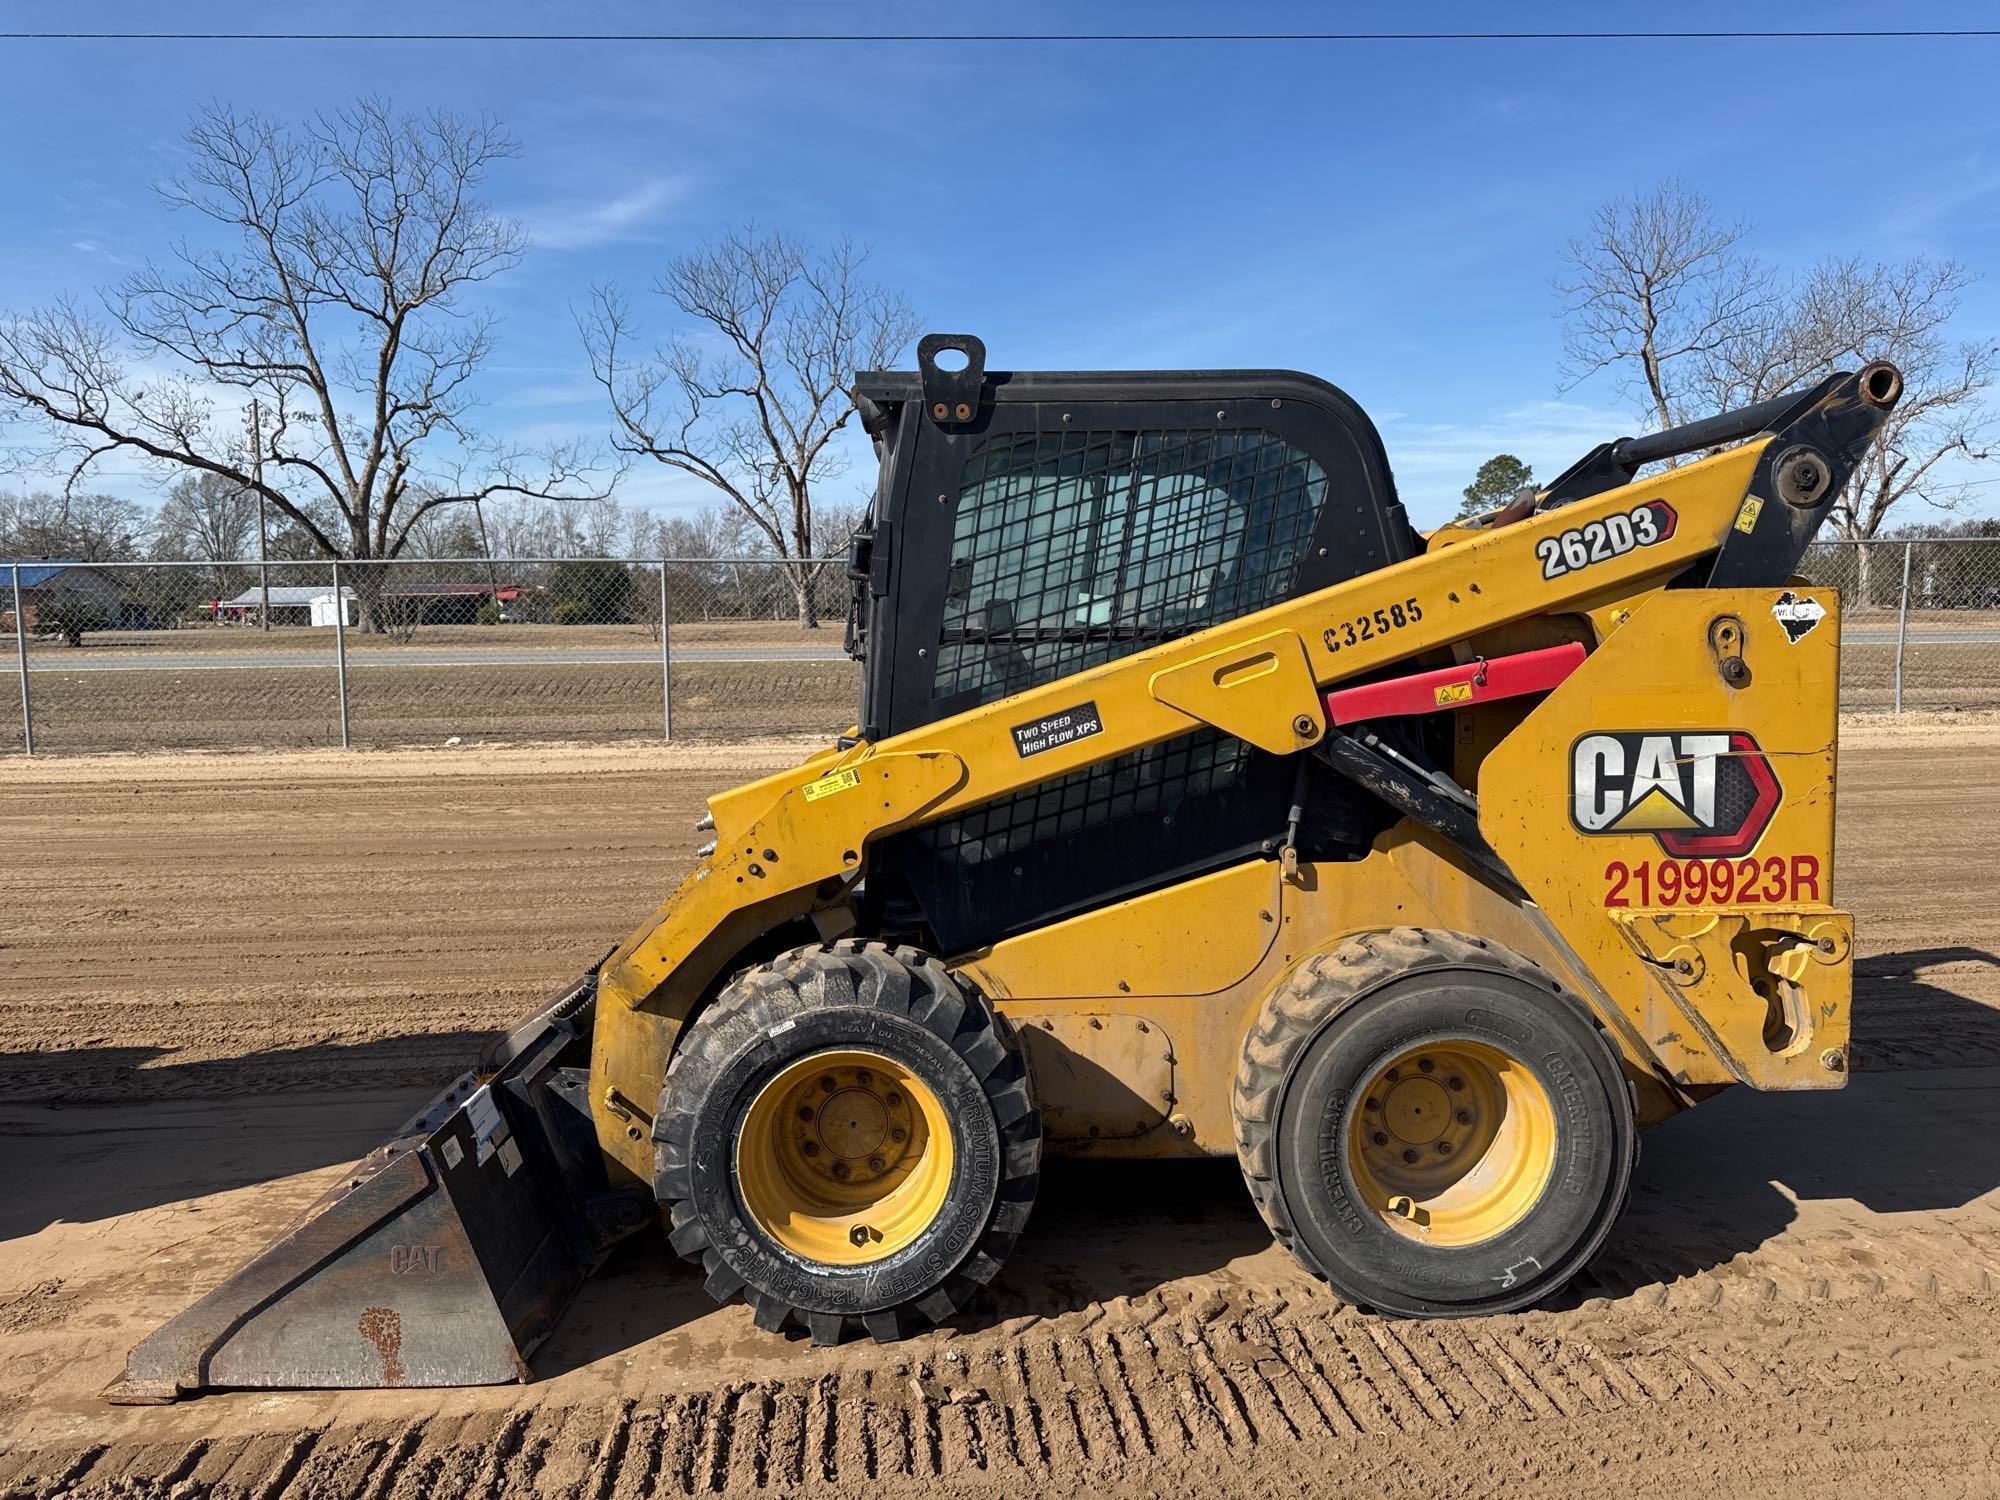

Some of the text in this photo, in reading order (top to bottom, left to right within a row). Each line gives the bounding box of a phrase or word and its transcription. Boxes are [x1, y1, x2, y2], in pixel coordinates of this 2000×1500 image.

[1538, 506, 1658, 580] 262D3
[1323, 597, 1423, 653] C32585
[1076, 720, 1098, 736] XPS
[1575, 735, 1730, 830] CAT
[1604, 855, 1820, 908] 2199923R
[840, 1024, 875, 1035] HEAVY
[906, 1041, 945, 1073] SIDEWALL
[1546, 1057, 1592, 1195] CATERPILLAR
[879, 1088, 990, 1299] PREMIUM SKID STEER
[1320, 1096, 1365, 1236] CATERPILLAR
[391, 1245, 440, 1274] CAT
